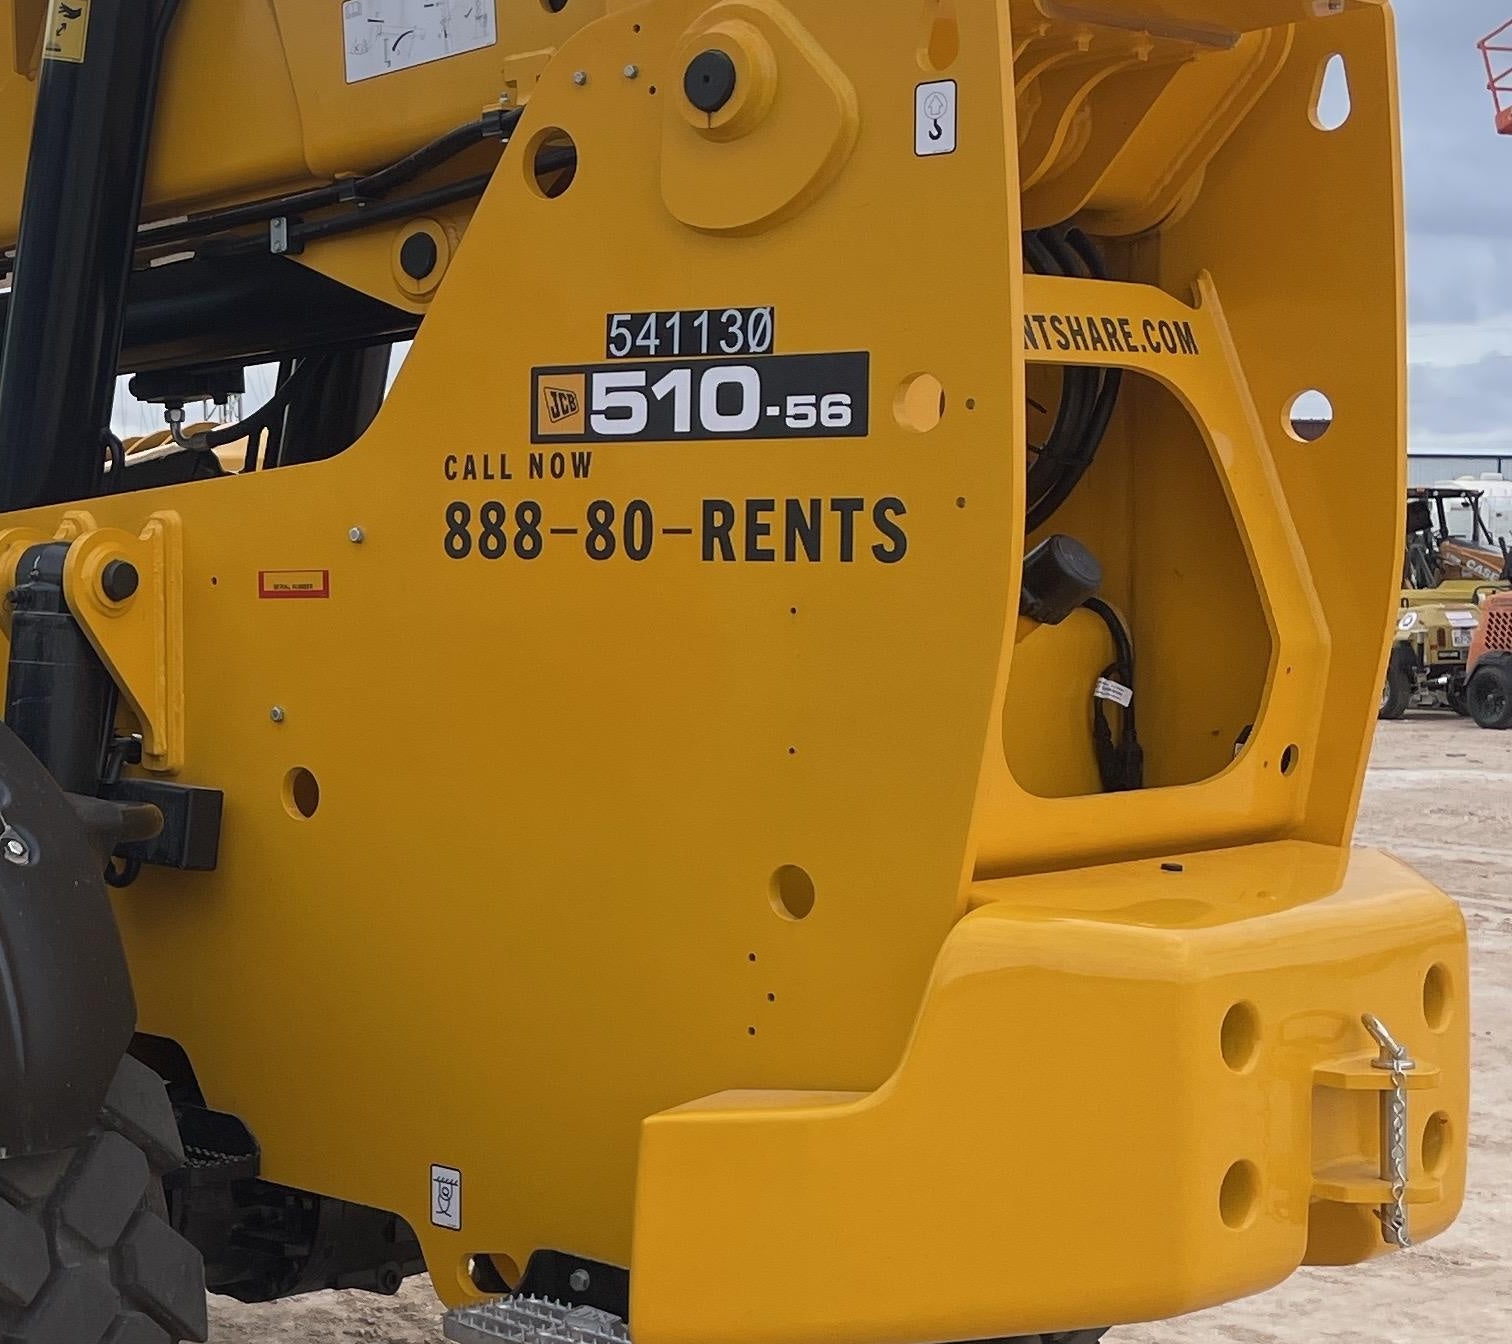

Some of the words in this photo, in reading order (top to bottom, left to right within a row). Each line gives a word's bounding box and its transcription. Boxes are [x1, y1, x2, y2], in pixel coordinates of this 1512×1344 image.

[608, 307, 773, 357] 541130
[550, 390, 577, 419] JCB
[444, 454, 513, 481] CALL
[529, 450, 593, 479] NOW
[443, 495, 908, 564] 888-80-RENTS
